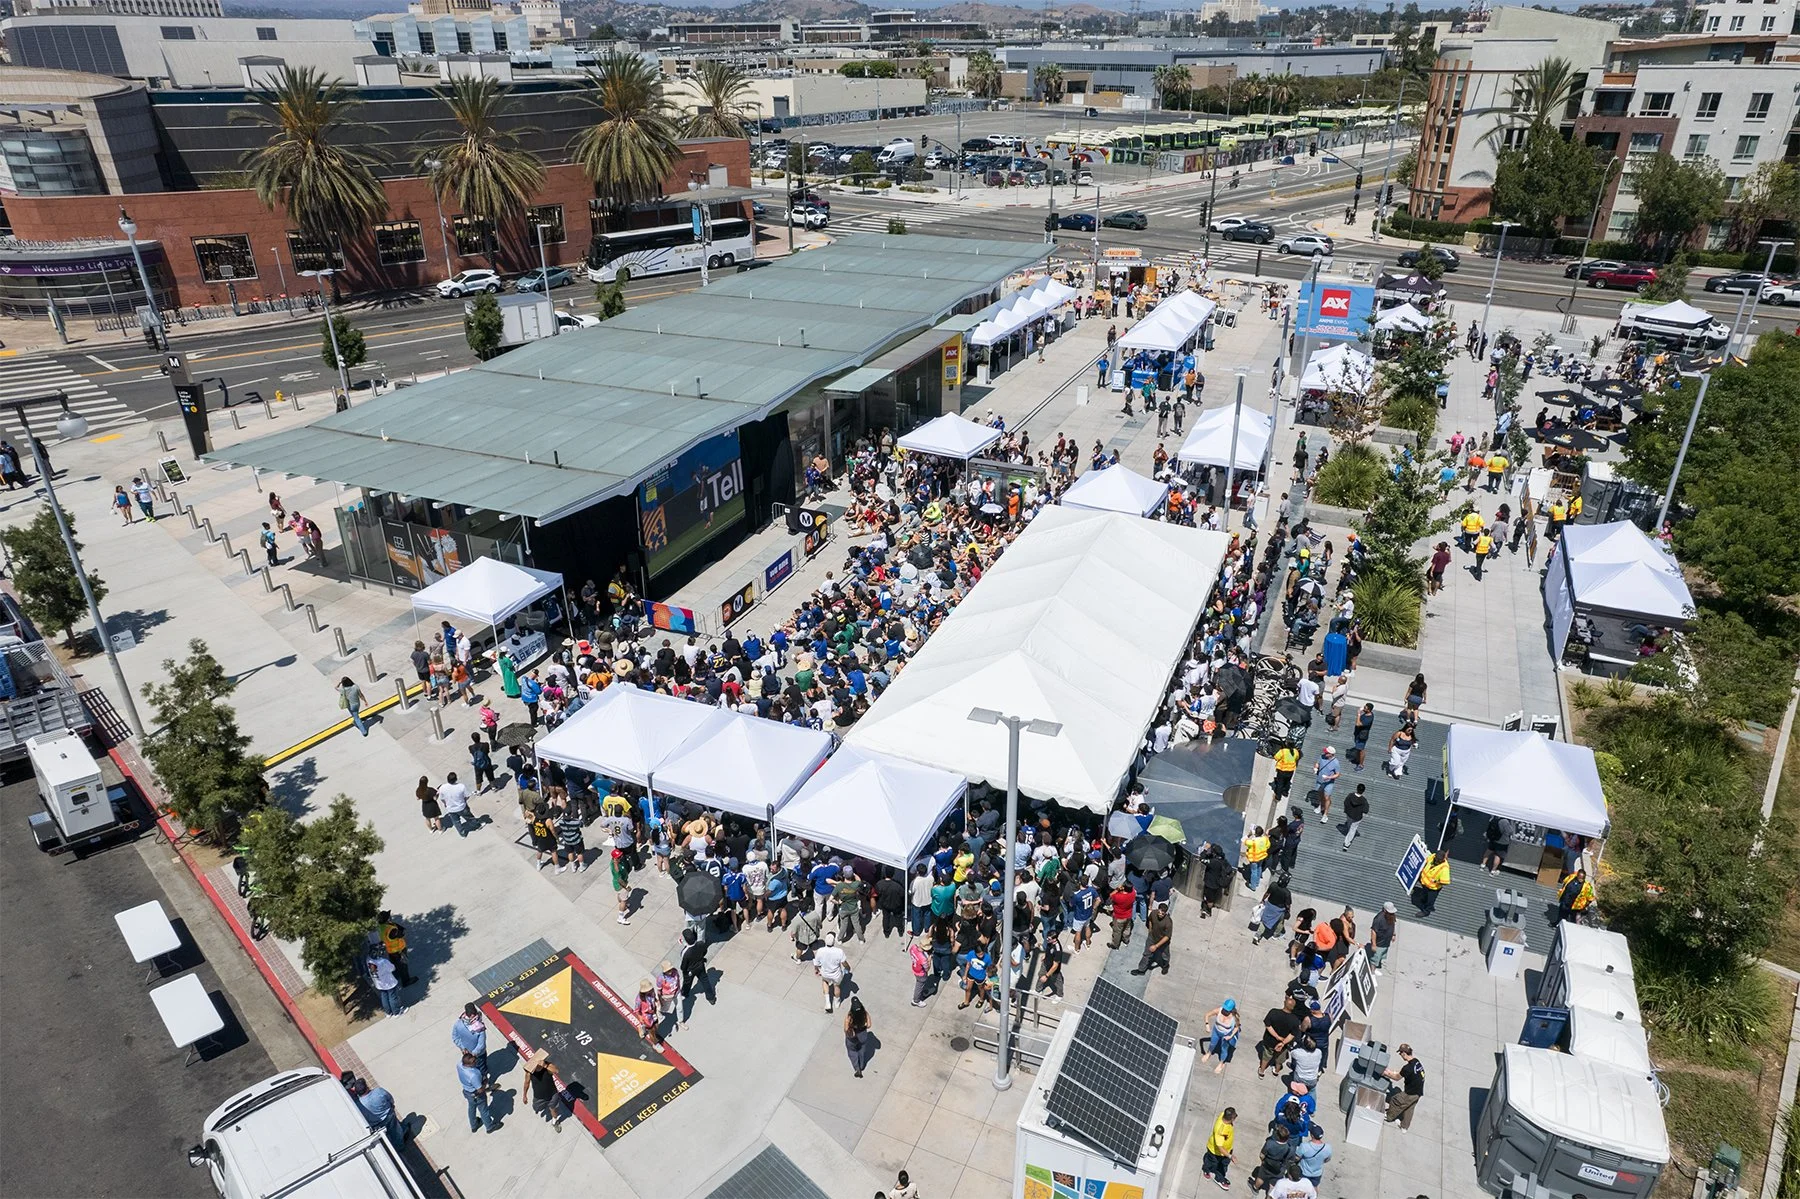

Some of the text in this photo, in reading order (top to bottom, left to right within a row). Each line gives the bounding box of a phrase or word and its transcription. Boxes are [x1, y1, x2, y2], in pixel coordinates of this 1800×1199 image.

[32, 264, 73, 272] Welcome
[1322, 297, 1349, 310] AX
[707, 458, 744, 508] Tell
[1082, 896, 1093, 910] 10
[542, 954, 559, 968] EXIT
[519, 966, 538, 981] KEEP
[488, 981, 514, 998] CLEAR
[534, 986, 550, 999] NO
[542, 996, 560, 1008] NO
[575, 1030, 592, 1046] 1/3
[611, 1069, 629, 1083] NO
[622, 1080, 639, 1094] NO
[614, 1120, 633, 1138] EXIT
[637, 1102, 658, 1121] KEEP
[662, 1081, 690, 1103] CLEAR
[1584, 1167, 1615, 1181] United
